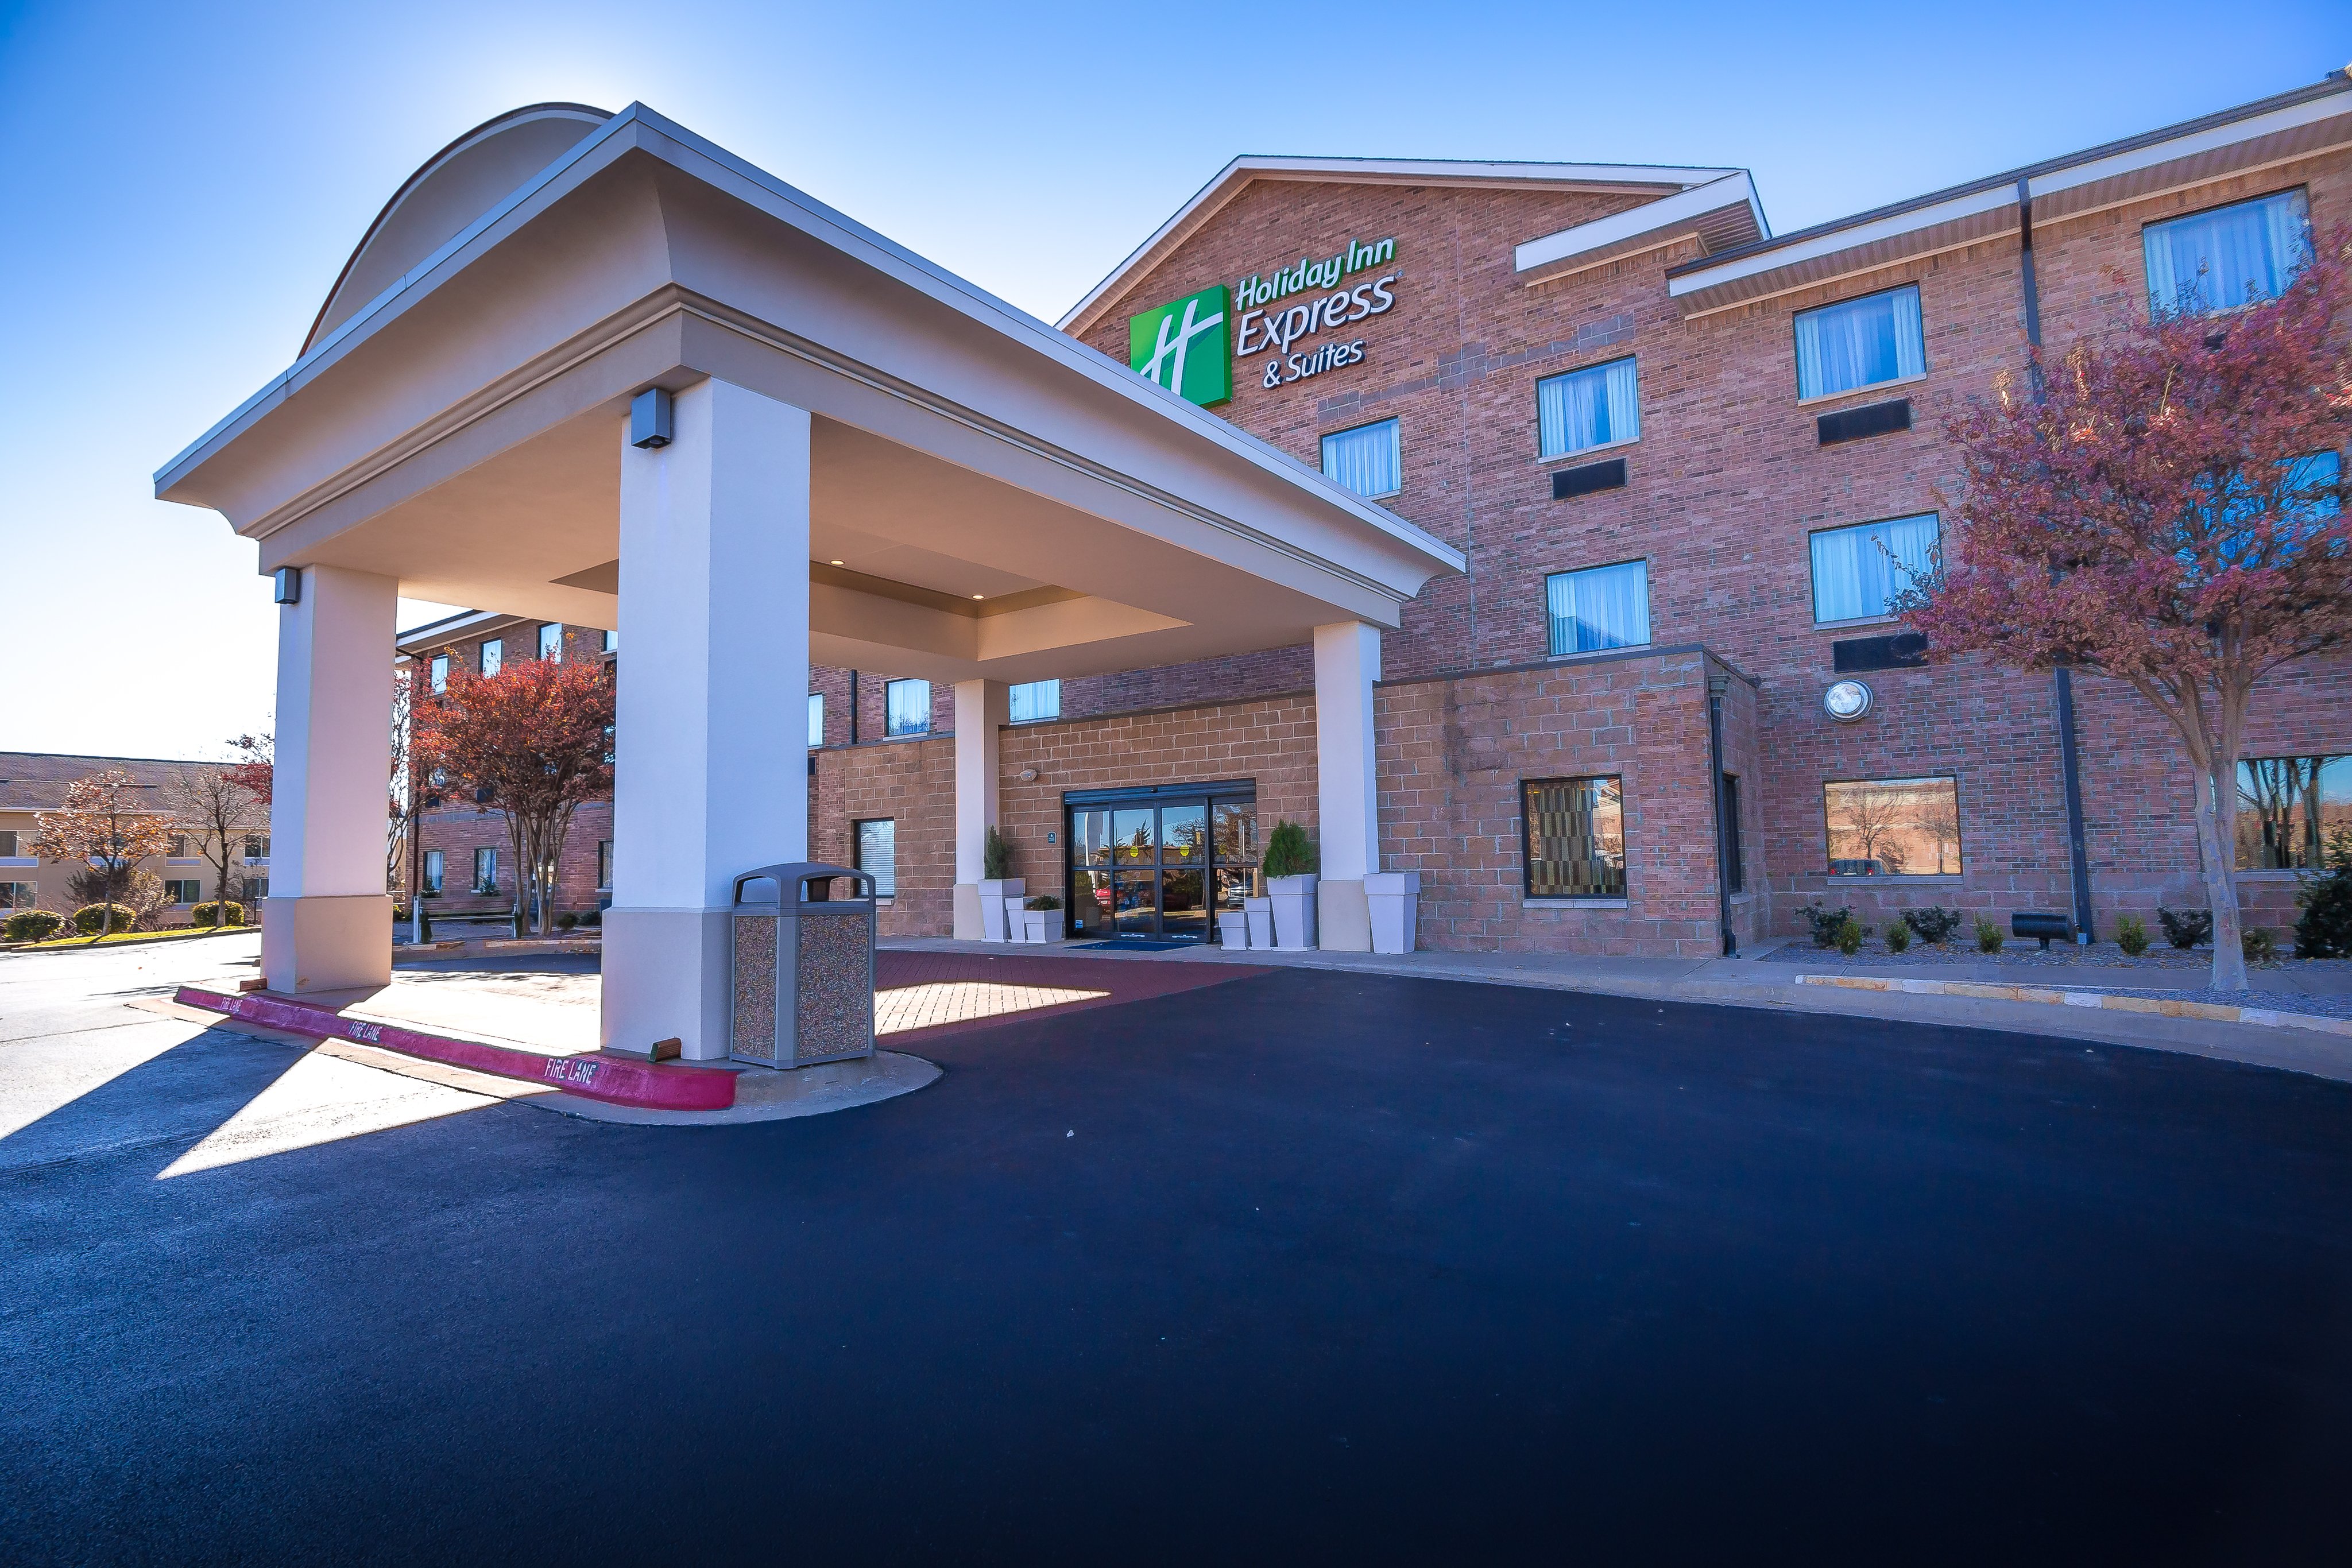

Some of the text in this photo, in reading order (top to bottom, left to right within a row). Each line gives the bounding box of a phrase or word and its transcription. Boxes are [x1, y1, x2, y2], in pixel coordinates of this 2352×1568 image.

[1235, 237, 1396, 311] Holiday Inn
[1237, 276, 1395, 357] Express
[1263, 340, 1365, 389] & Suites
[220, 997, 243, 1012] FIRE LANE
[349, 1021, 383, 1041] FIRE LANE
[544, 1058, 597, 1084] FIRE LANE
